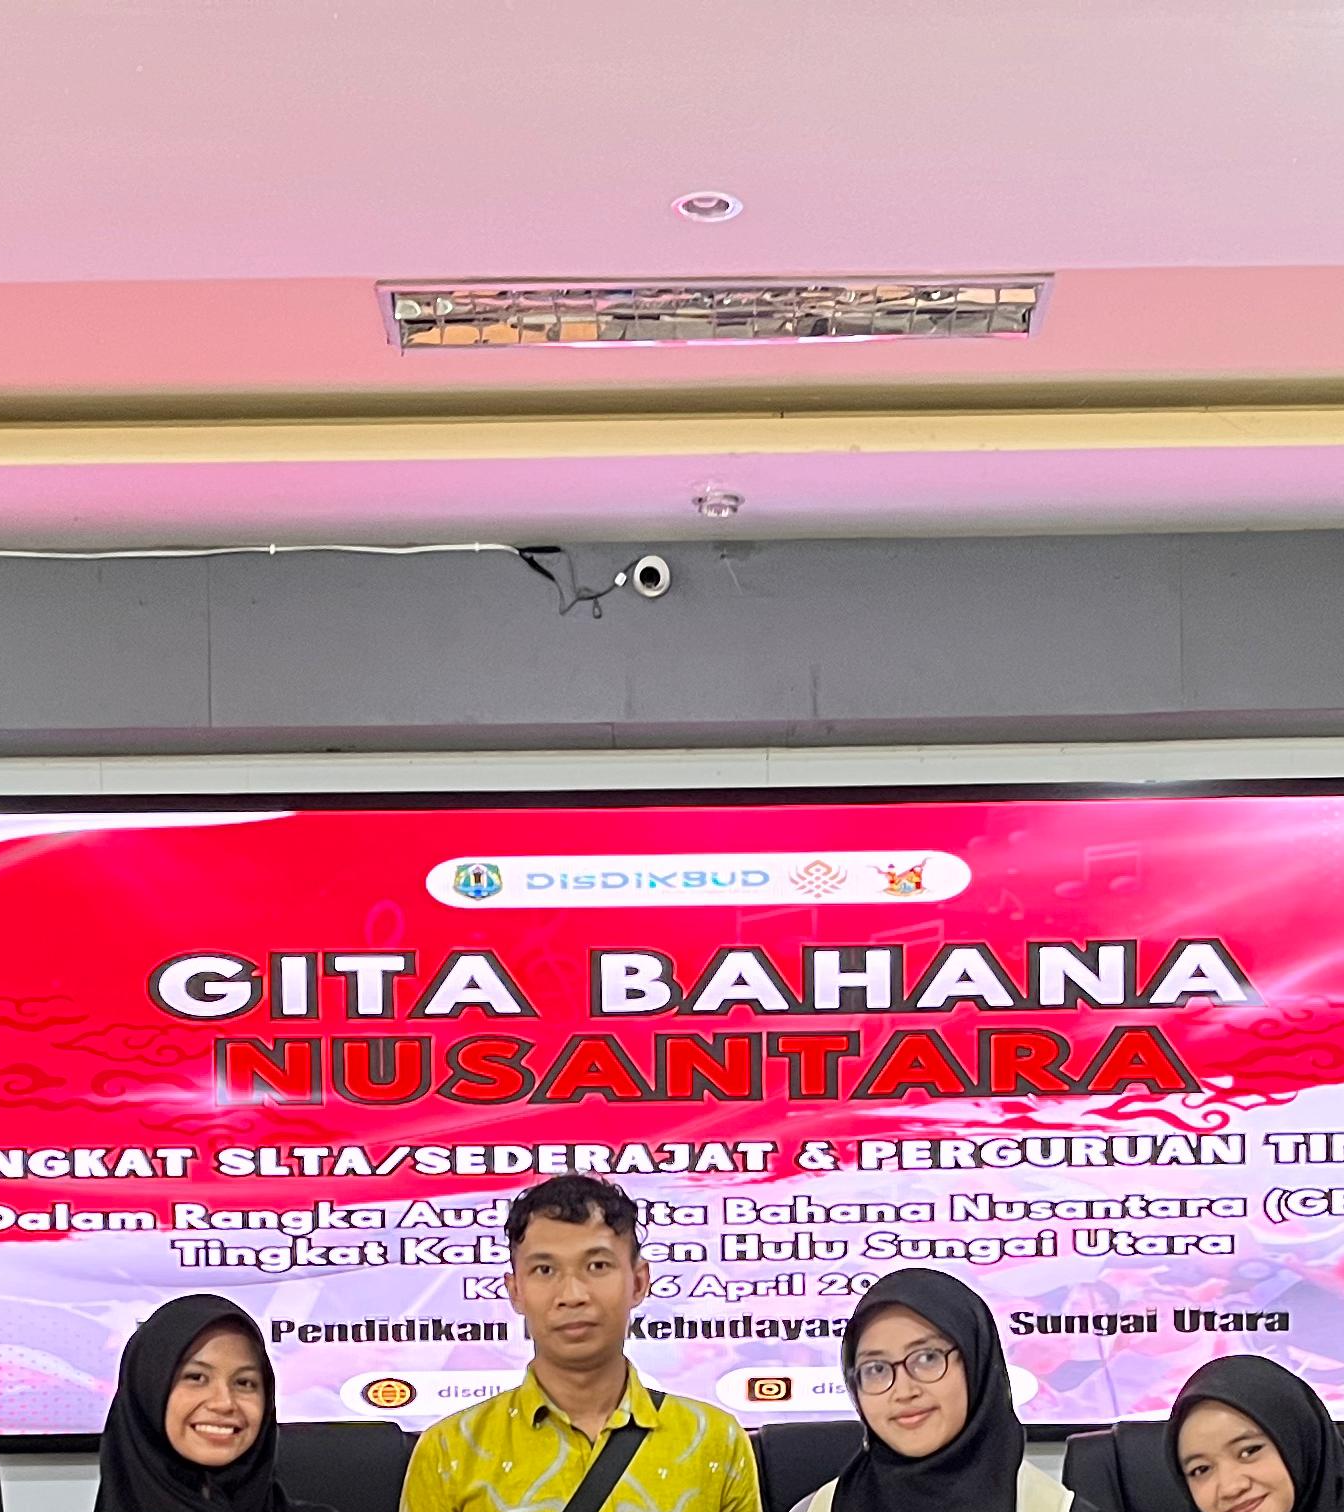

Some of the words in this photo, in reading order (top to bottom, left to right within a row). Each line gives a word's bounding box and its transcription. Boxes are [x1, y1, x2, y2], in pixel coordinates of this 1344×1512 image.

[151, 949, 534, 1020] GITA
[593, 938, 1258, 1017] BAHANA
[215, 1022, 1203, 1106] NUSANTARA
[218, 1141, 778, 1179] SLTA/SEDERAJAT
[794, 1140, 838, 1171] &
[859, 1131, 1246, 1172] PERGURUAN
[173, 1202, 385, 1236] Rangka
[399, 1198, 512, 1230] Aud
[634, 1198, 708, 1226] ita
[723, 1196, 936, 1226] Bahana
[949, 1190, 1247, 1223] Nusantara
[171, 1238, 388, 1273] Tingkat
[721, 1232, 846, 1262] Hulu
[861, 1230, 1056, 1264] Sungai
[1073, 1227, 1236, 1256] Utara
[646, 1274, 682, 1298] 6
[689, 1272, 806, 1303] April
[818, 1271, 880, 1296] 20
[271, 1316, 508, 1345] Pendidikan
[628, 1310, 850, 1341] Kebudayaa
[1009, 1310, 1158, 1336] Sungai
[1173, 1306, 1290, 1333] Utara
